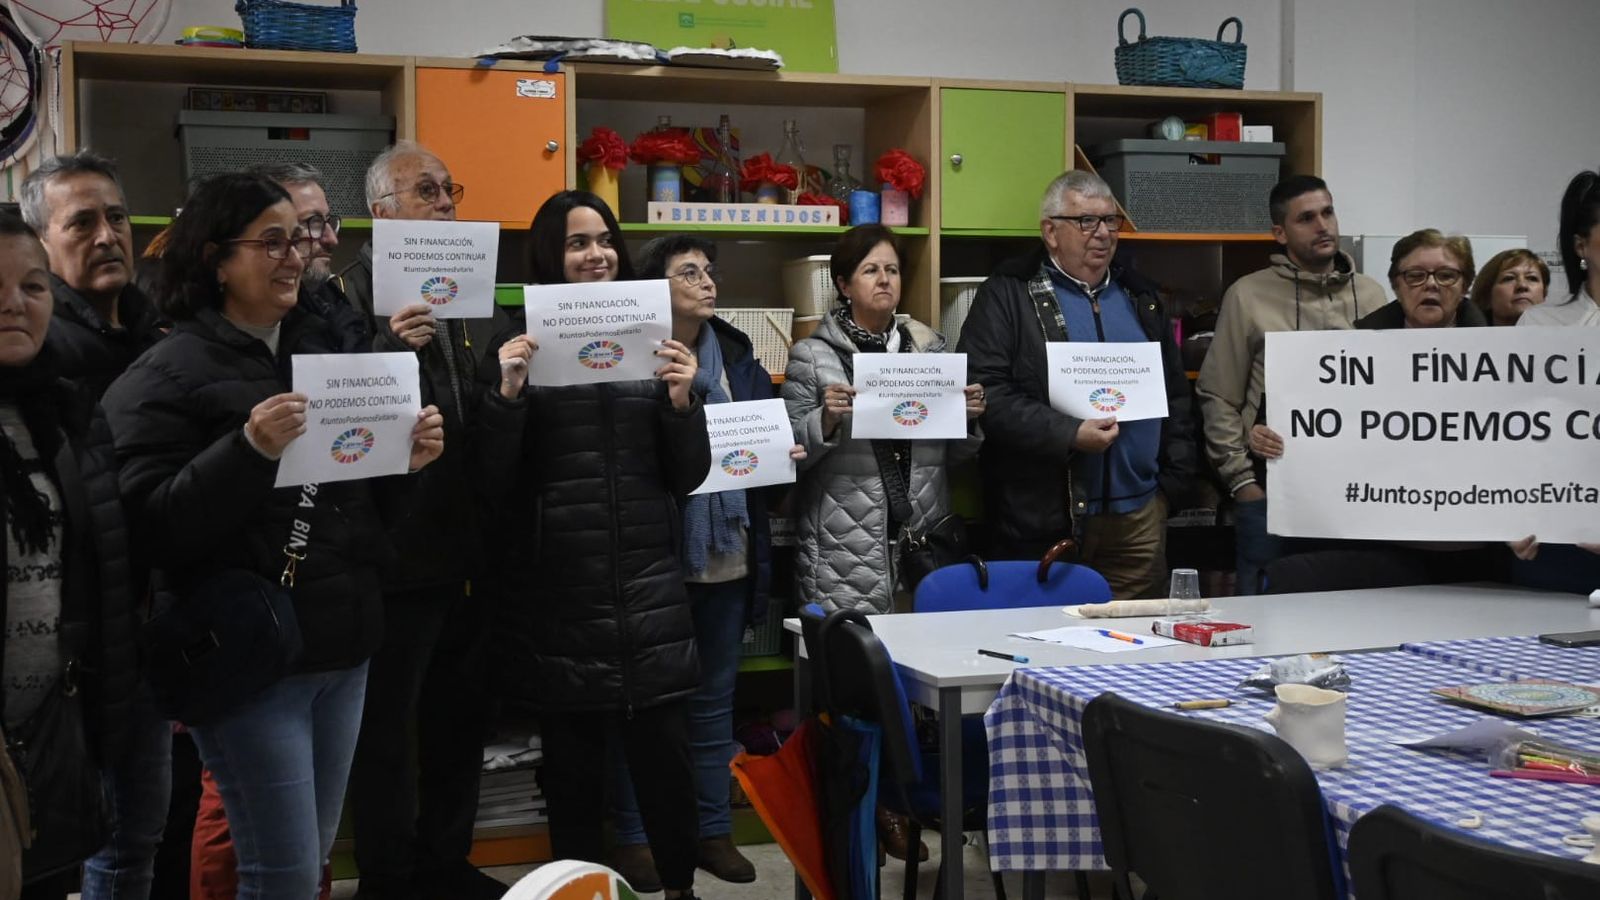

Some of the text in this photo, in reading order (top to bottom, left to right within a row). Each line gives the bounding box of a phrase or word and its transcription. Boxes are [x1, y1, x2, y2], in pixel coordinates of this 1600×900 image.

[671, 207, 822, 223] BIENVENIDOS
[403, 236, 474, 248] SIN FINANCIACIÓN,
[388, 252, 487, 260] NO PODEMOS CONTINUAR
[558, 297, 640, 311] SIN FINANCIACIÓN,
[542, 312, 657, 327] NO PODEMOS CONTINUAR
[1072, 354, 1136, 364] SIN FINANCIACIÓN,
[880, 365, 943, 375] SIN FINANCIACIÓN,
[1060, 366, 1151, 375] NO PODEMOS CONTINUAR
[326, 375, 399, 389] SIN FINANCIACIÓN,
[865, 379, 955, 388] NO PODEMOS CONTINUAR
[309, 394, 412, 410] NO PODEMOS CONTINUAR
[709, 424, 780, 439] ODEMOS CONTINUAR
[1290, 408, 1342, 439] NO
[1360, 410, 1551, 442] PODEMOS
[298, 482, 319, 508] BA
[1345, 482, 1599, 512] #JuntospodemosEvita
